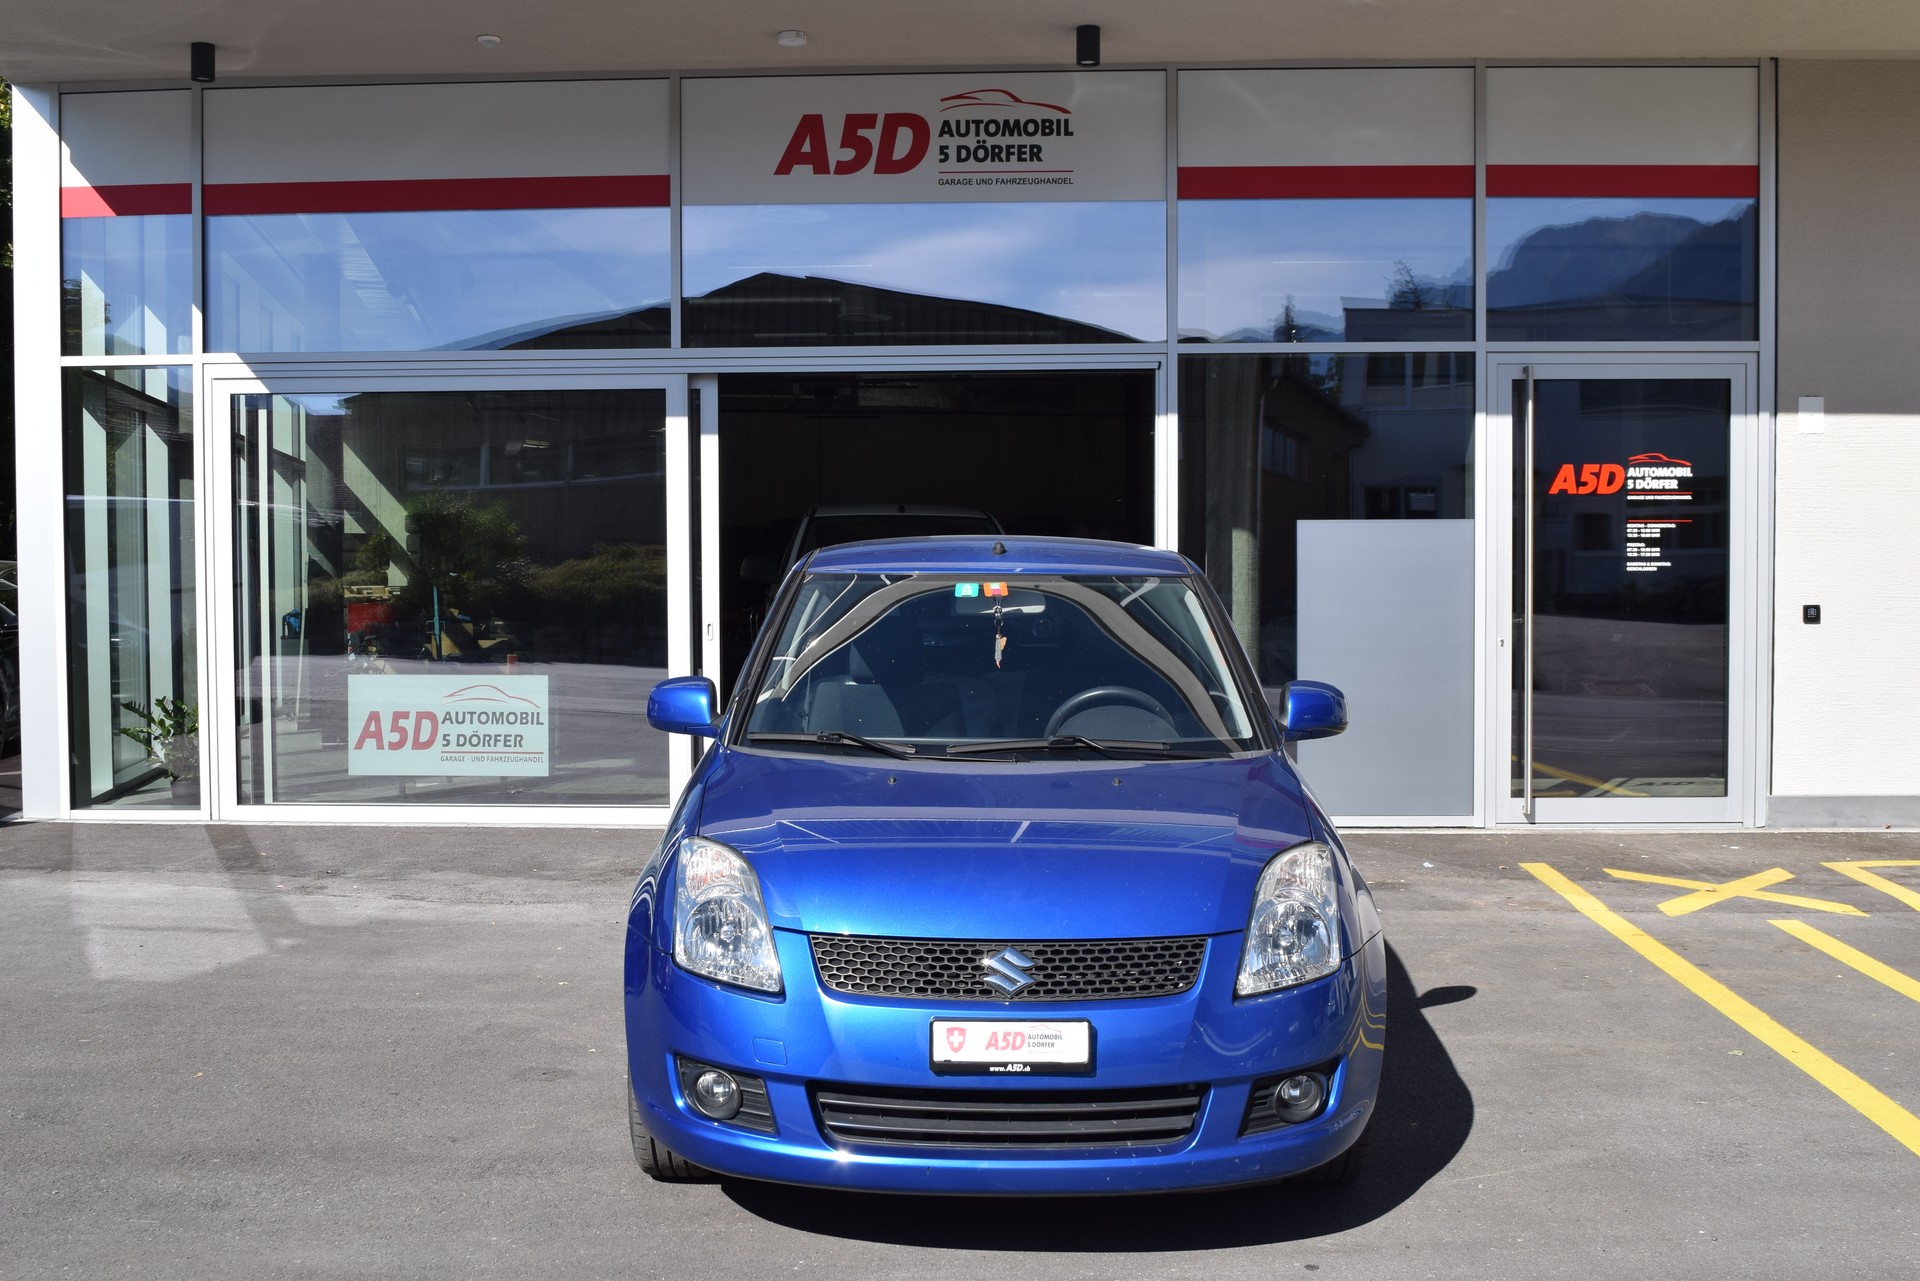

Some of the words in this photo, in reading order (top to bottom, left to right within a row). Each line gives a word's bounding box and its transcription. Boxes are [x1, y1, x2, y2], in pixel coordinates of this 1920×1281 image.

[938, 118, 1074, 138] AUTOMOBIL
[773, 112, 931, 176] A5D
[938, 145, 950, 163] 5
[956, 139, 1043, 163] DÖRFER
[938, 178, 974, 186] GARAGE
[975, 177, 994, 186] UND
[995, 176, 1074, 186] FAHRZEUGHANDEL
[1549, 463, 1626, 495] A5D
[1627, 467, 1693, 477] AUTOMOBIL
[1627, 479, 1635, 489] 5
[1636, 477, 1679, 490] DÖRFER
[442, 711, 544, 726] AUTOMOBIL
[354, 711, 439, 751] A5D
[442, 734, 450, 748] 5
[456, 730, 524, 748] DÖRFER
[486, 756, 544, 764] FAHRZEUGHANDEL
[985, 1031, 1026, 1051] A5D
[989, 1063, 1031, 1072] www.A5D.ch
